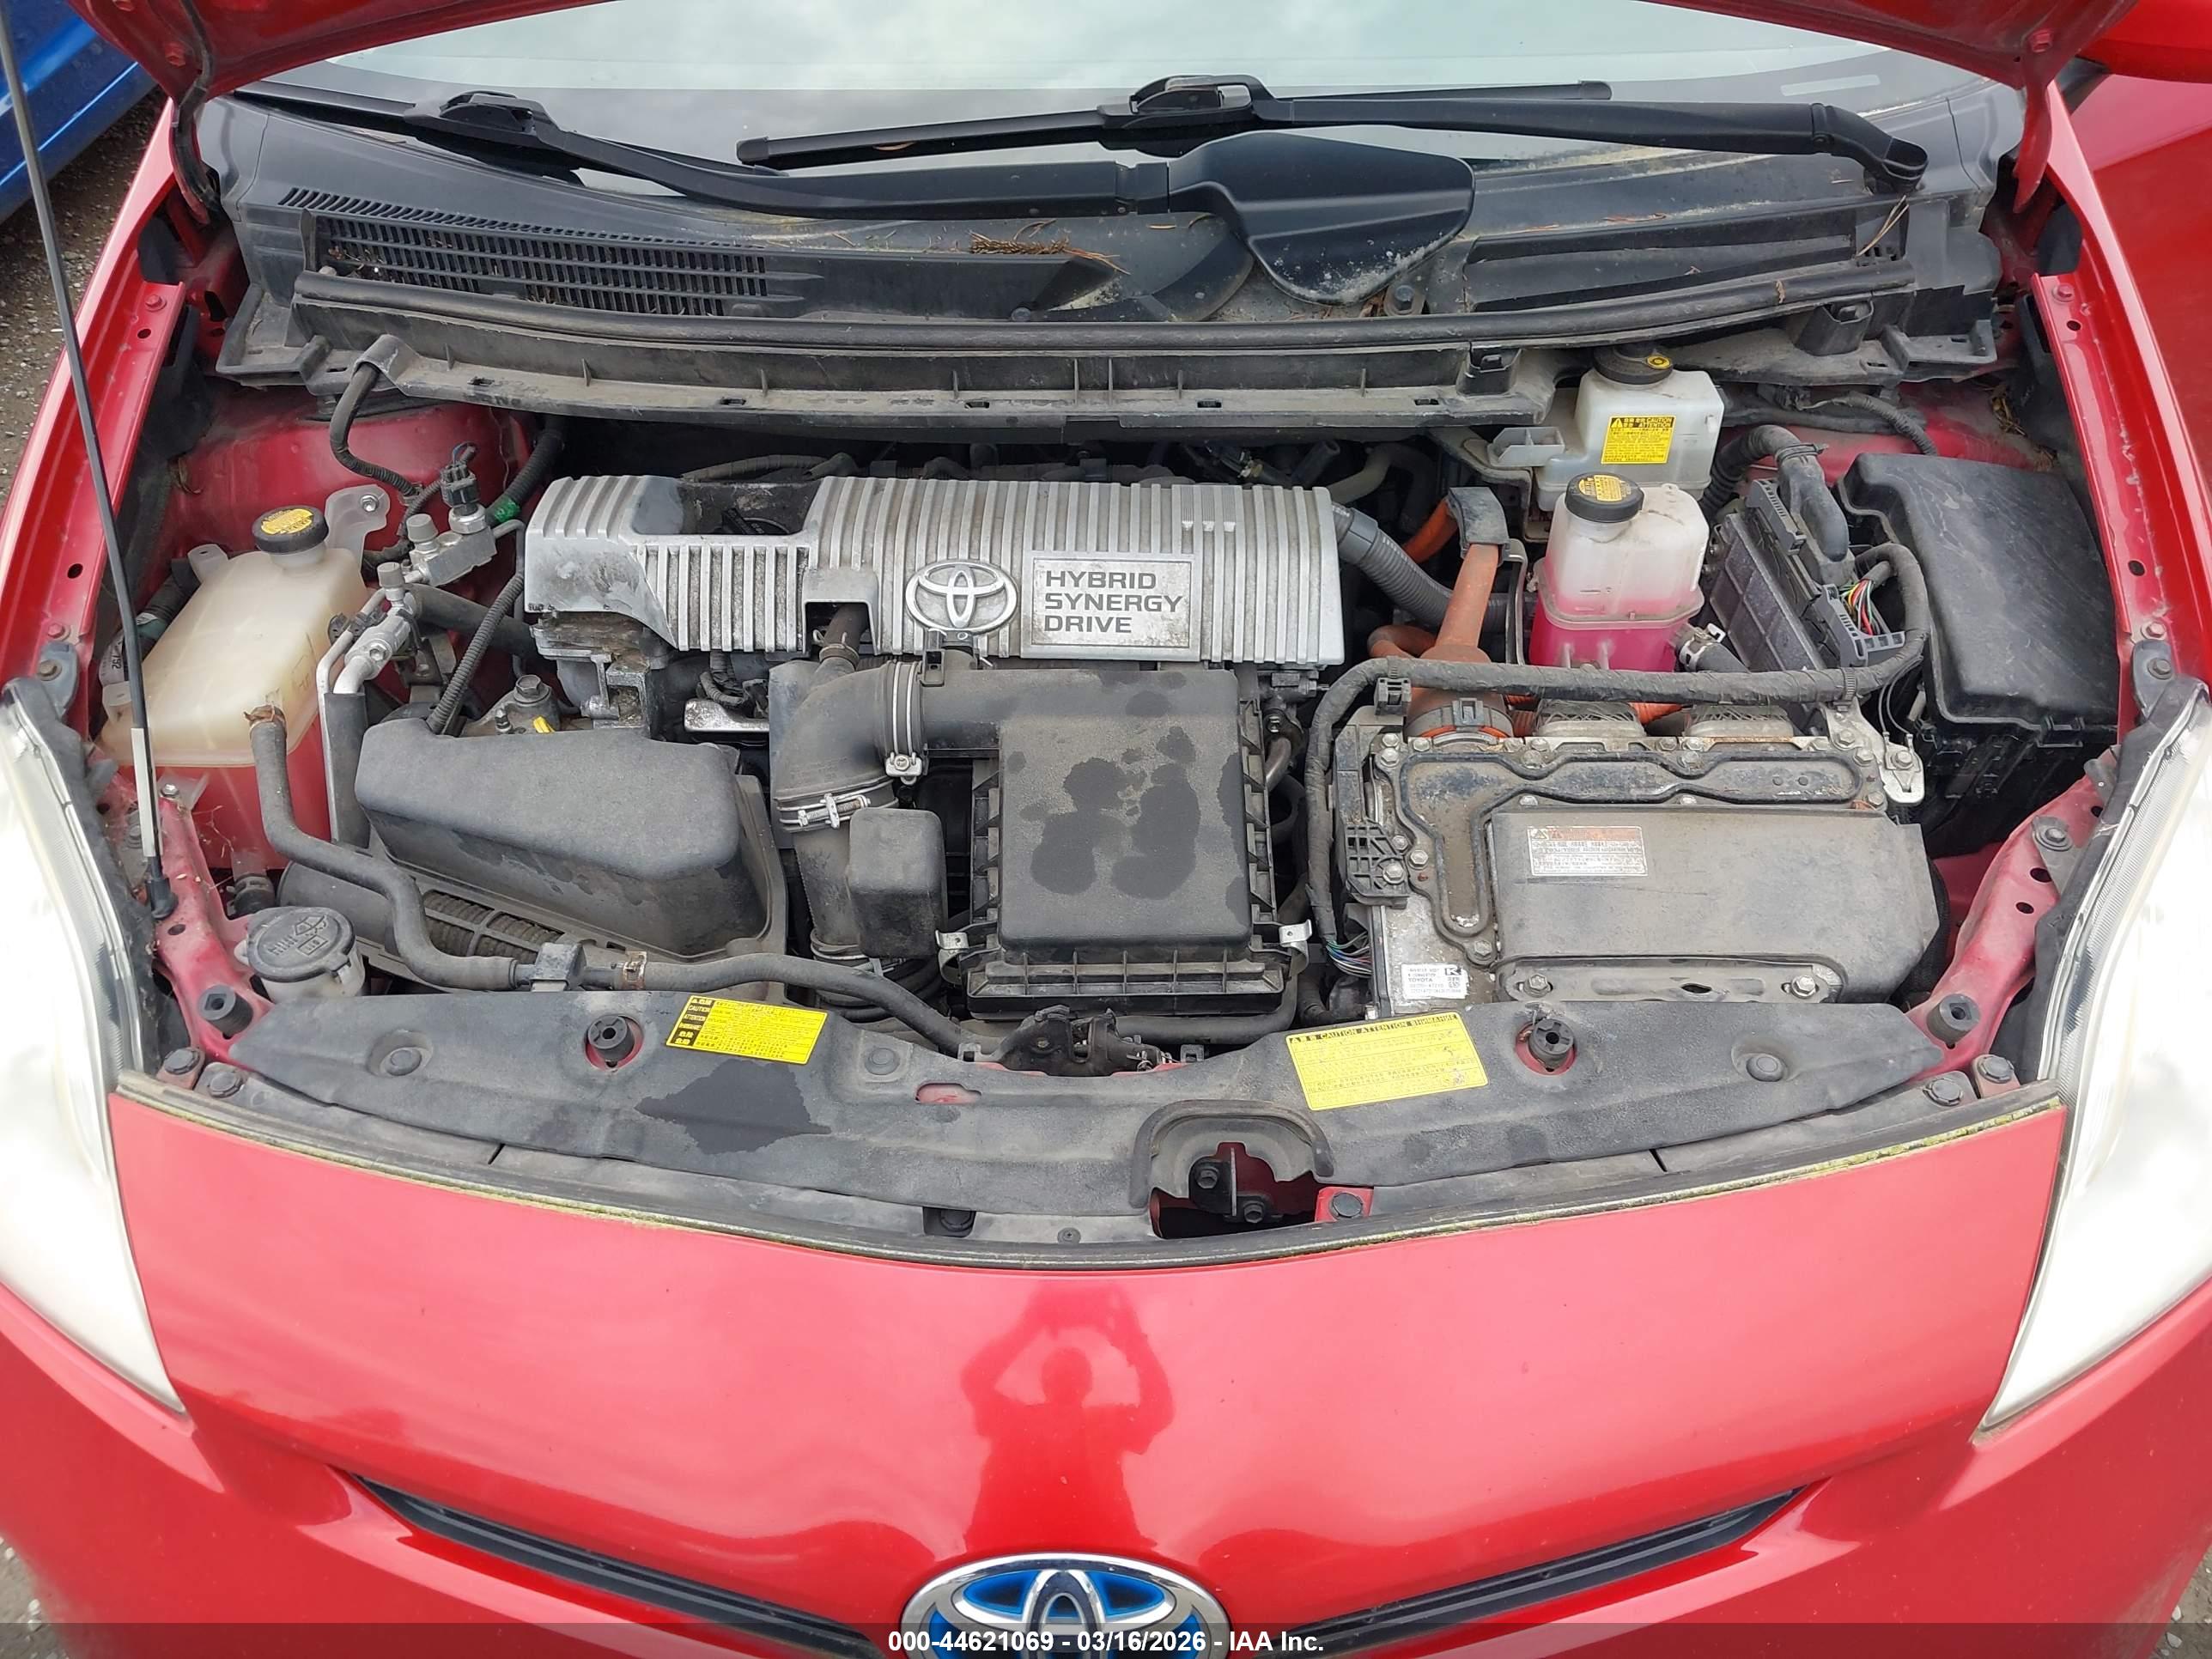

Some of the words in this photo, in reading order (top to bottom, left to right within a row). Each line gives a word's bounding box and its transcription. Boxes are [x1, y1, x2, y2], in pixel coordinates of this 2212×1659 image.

[1046, 570, 1157, 589] HYBRID
[1045, 592, 1183, 612] SYNERGY
[1044, 615, 1133, 633] DRIVE
[1321, 1029, 1356, 1041] CAUTION
[1361, 1021, 1407, 1034] ATTENTION
